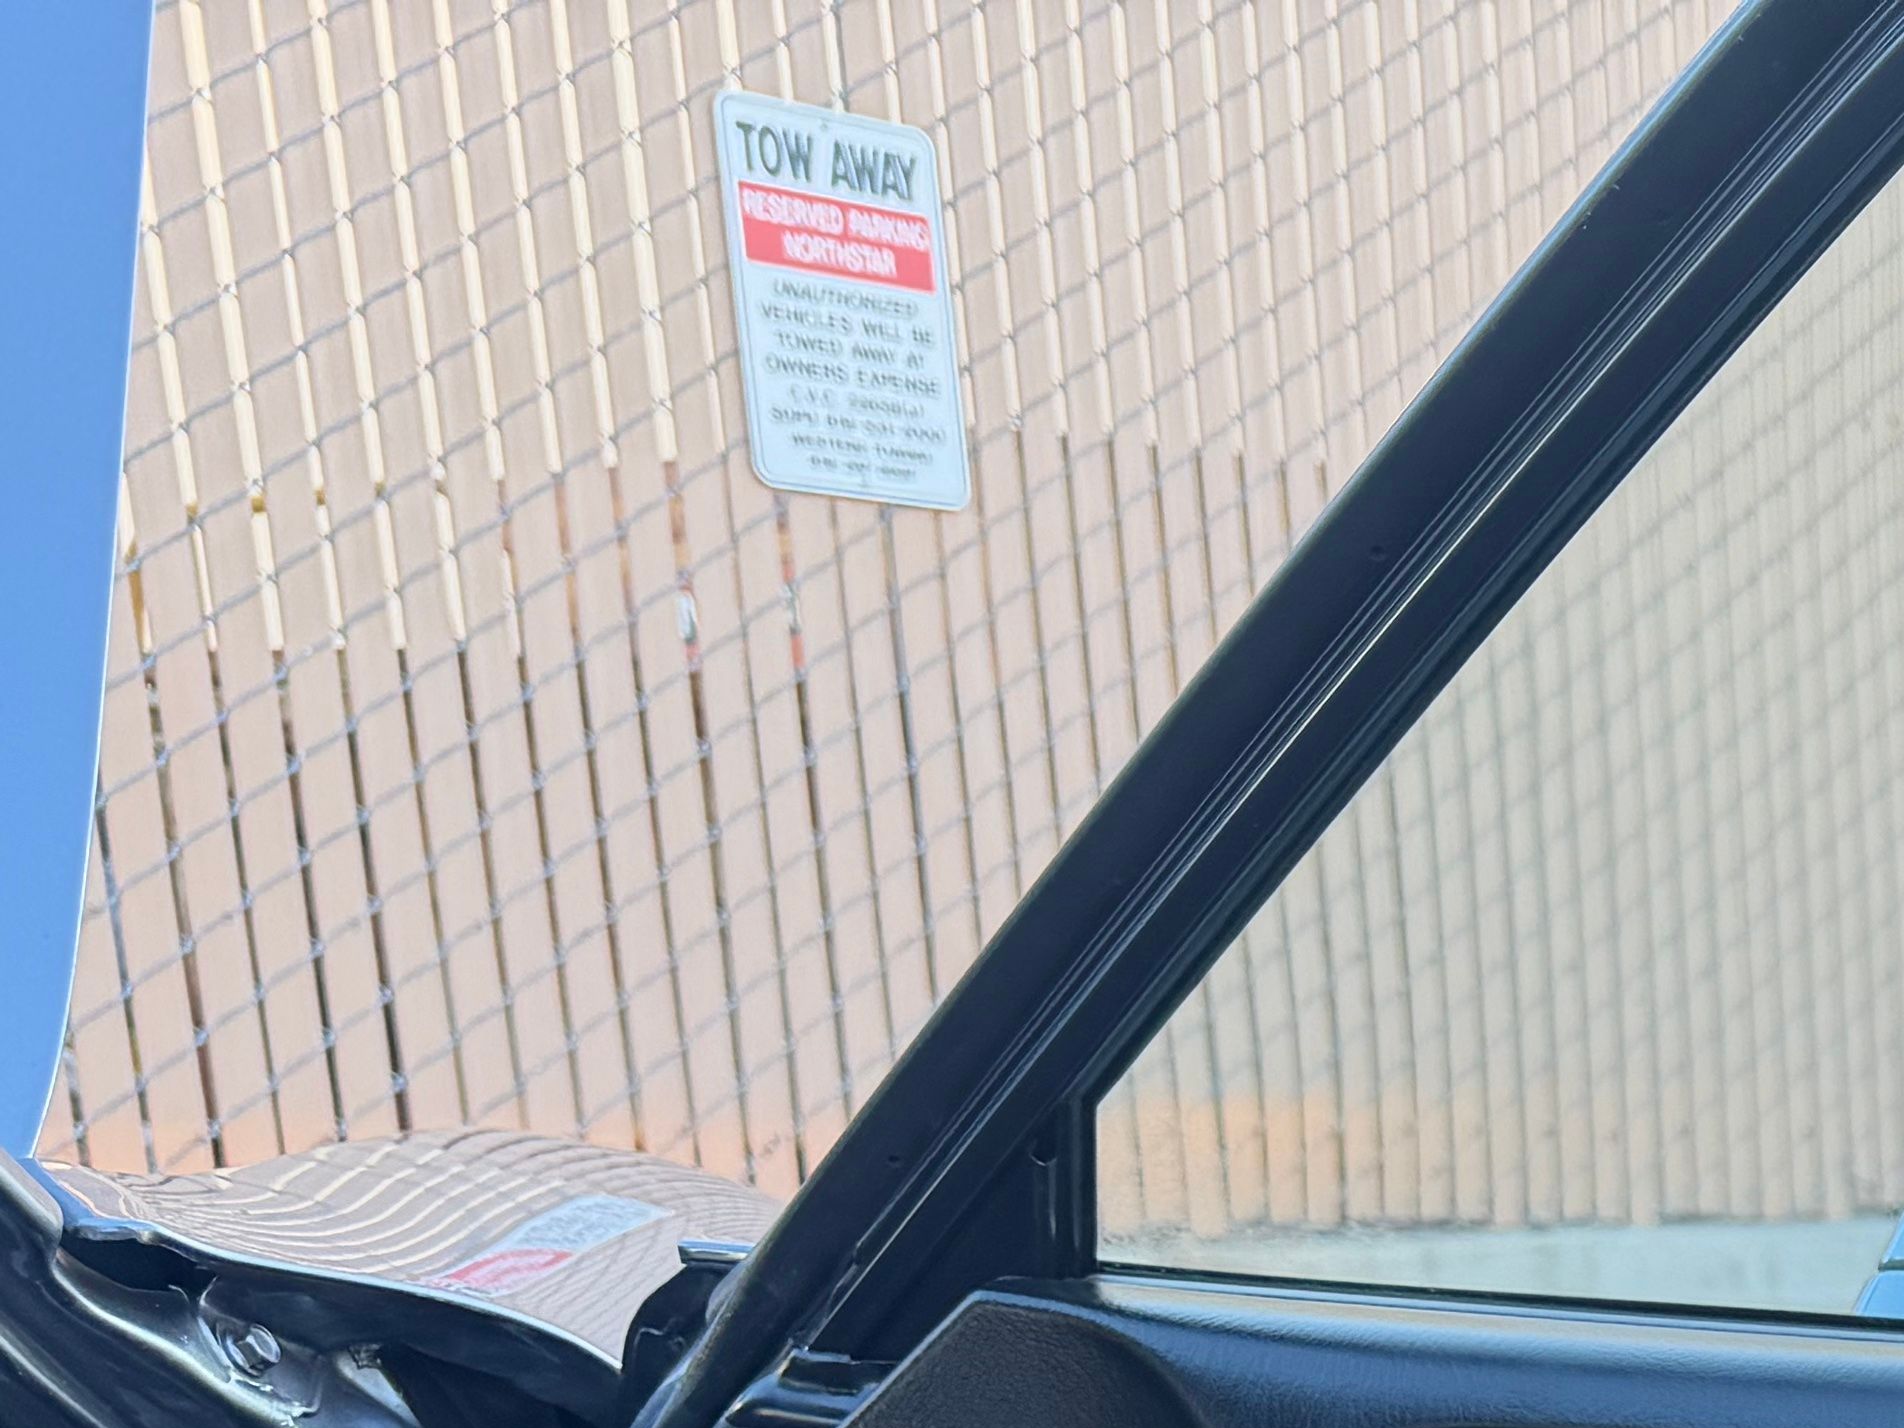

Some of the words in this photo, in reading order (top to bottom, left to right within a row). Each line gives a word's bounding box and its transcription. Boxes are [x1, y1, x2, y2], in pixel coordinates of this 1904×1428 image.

[735, 121, 813, 182] TOW
[831, 139, 918, 202] AWAY
[742, 188, 845, 236] RESERVED
[848, 210, 931, 252] PARKING
[782, 231, 898, 279] NORTHSTAR
[773, 279, 918, 316] UNAUTHORIZED
[761, 302, 850, 332] VEHICLES
[861, 319, 901, 339] WILL
[775, 331, 843, 355] TOWED
[857, 369, 940, 396] EXPENSE
